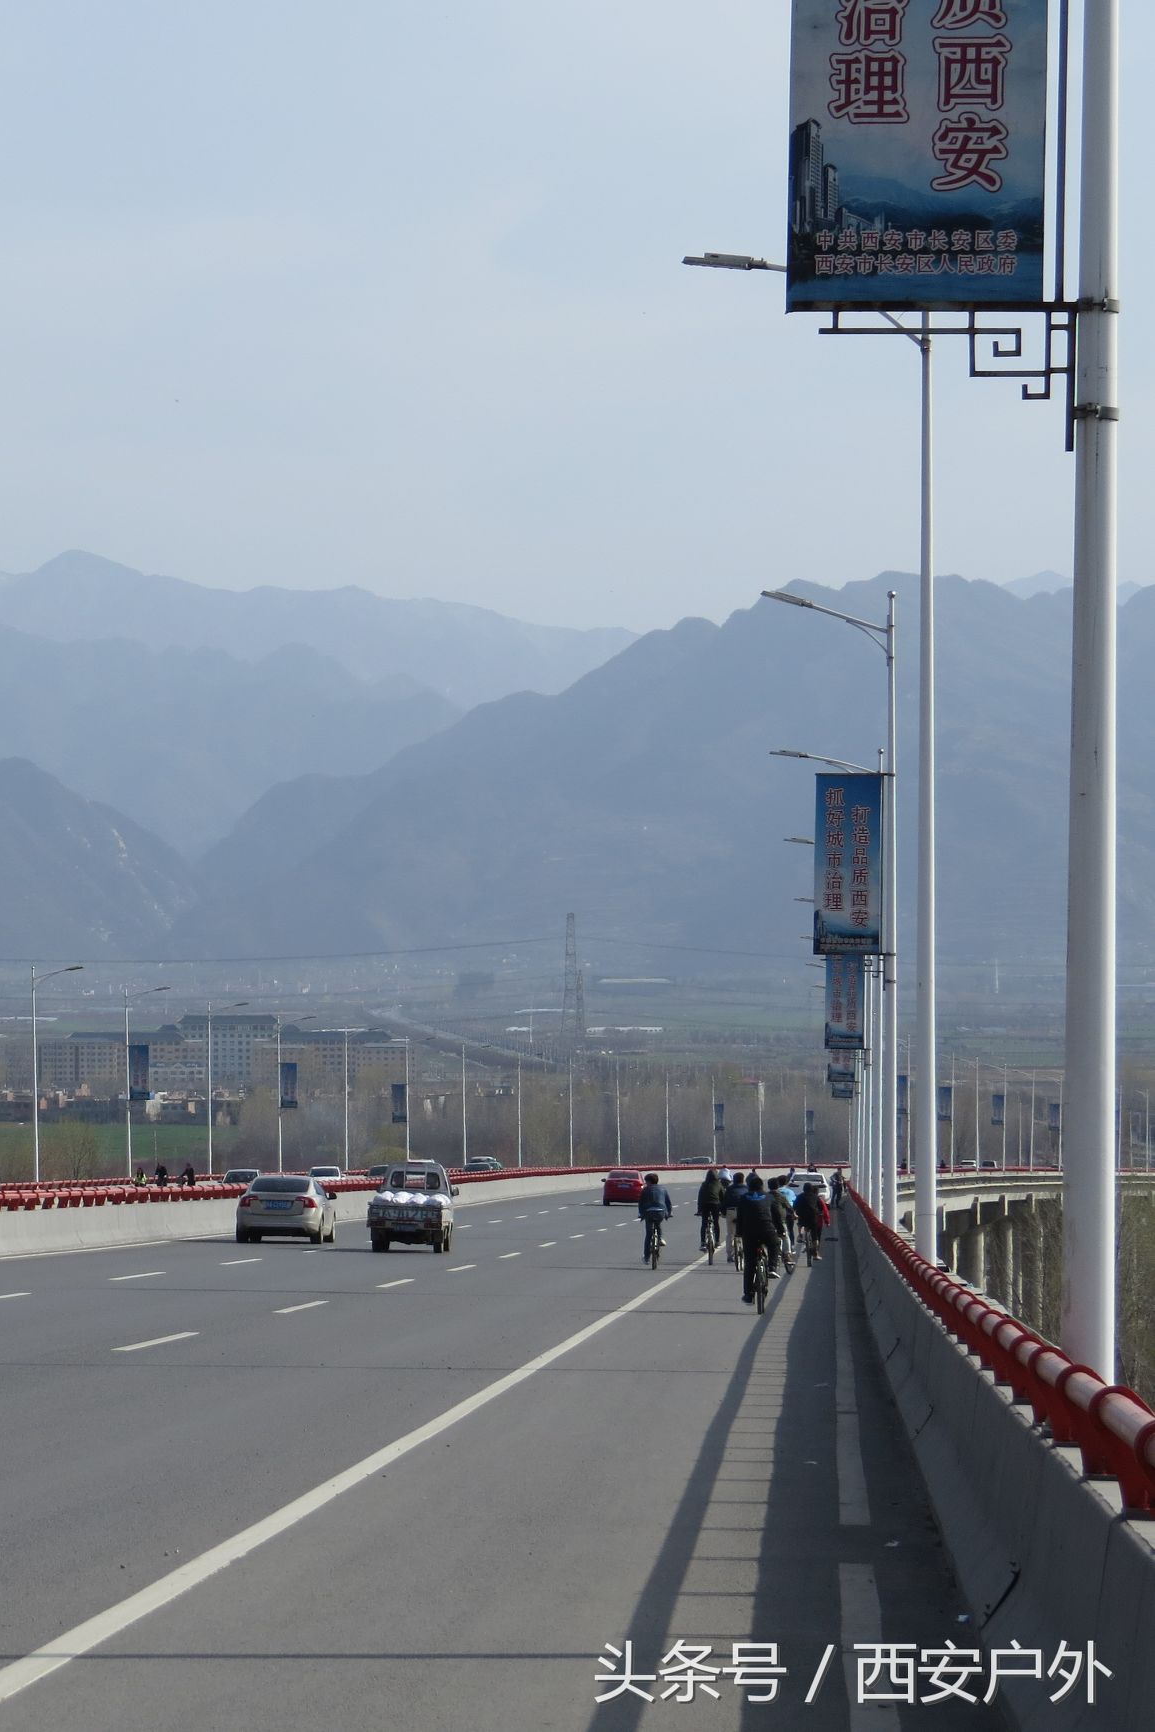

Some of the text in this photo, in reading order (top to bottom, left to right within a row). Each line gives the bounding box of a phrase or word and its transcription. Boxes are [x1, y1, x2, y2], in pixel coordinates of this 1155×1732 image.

[815, 253, 1018, 275] 西安市长安区人民政府
[816, 229, 1018, 251] 中共西安市长安区委
[824, 787, 845, 912] 抓好城市治理
[850, 805, 870, 928] 打造品质西安
